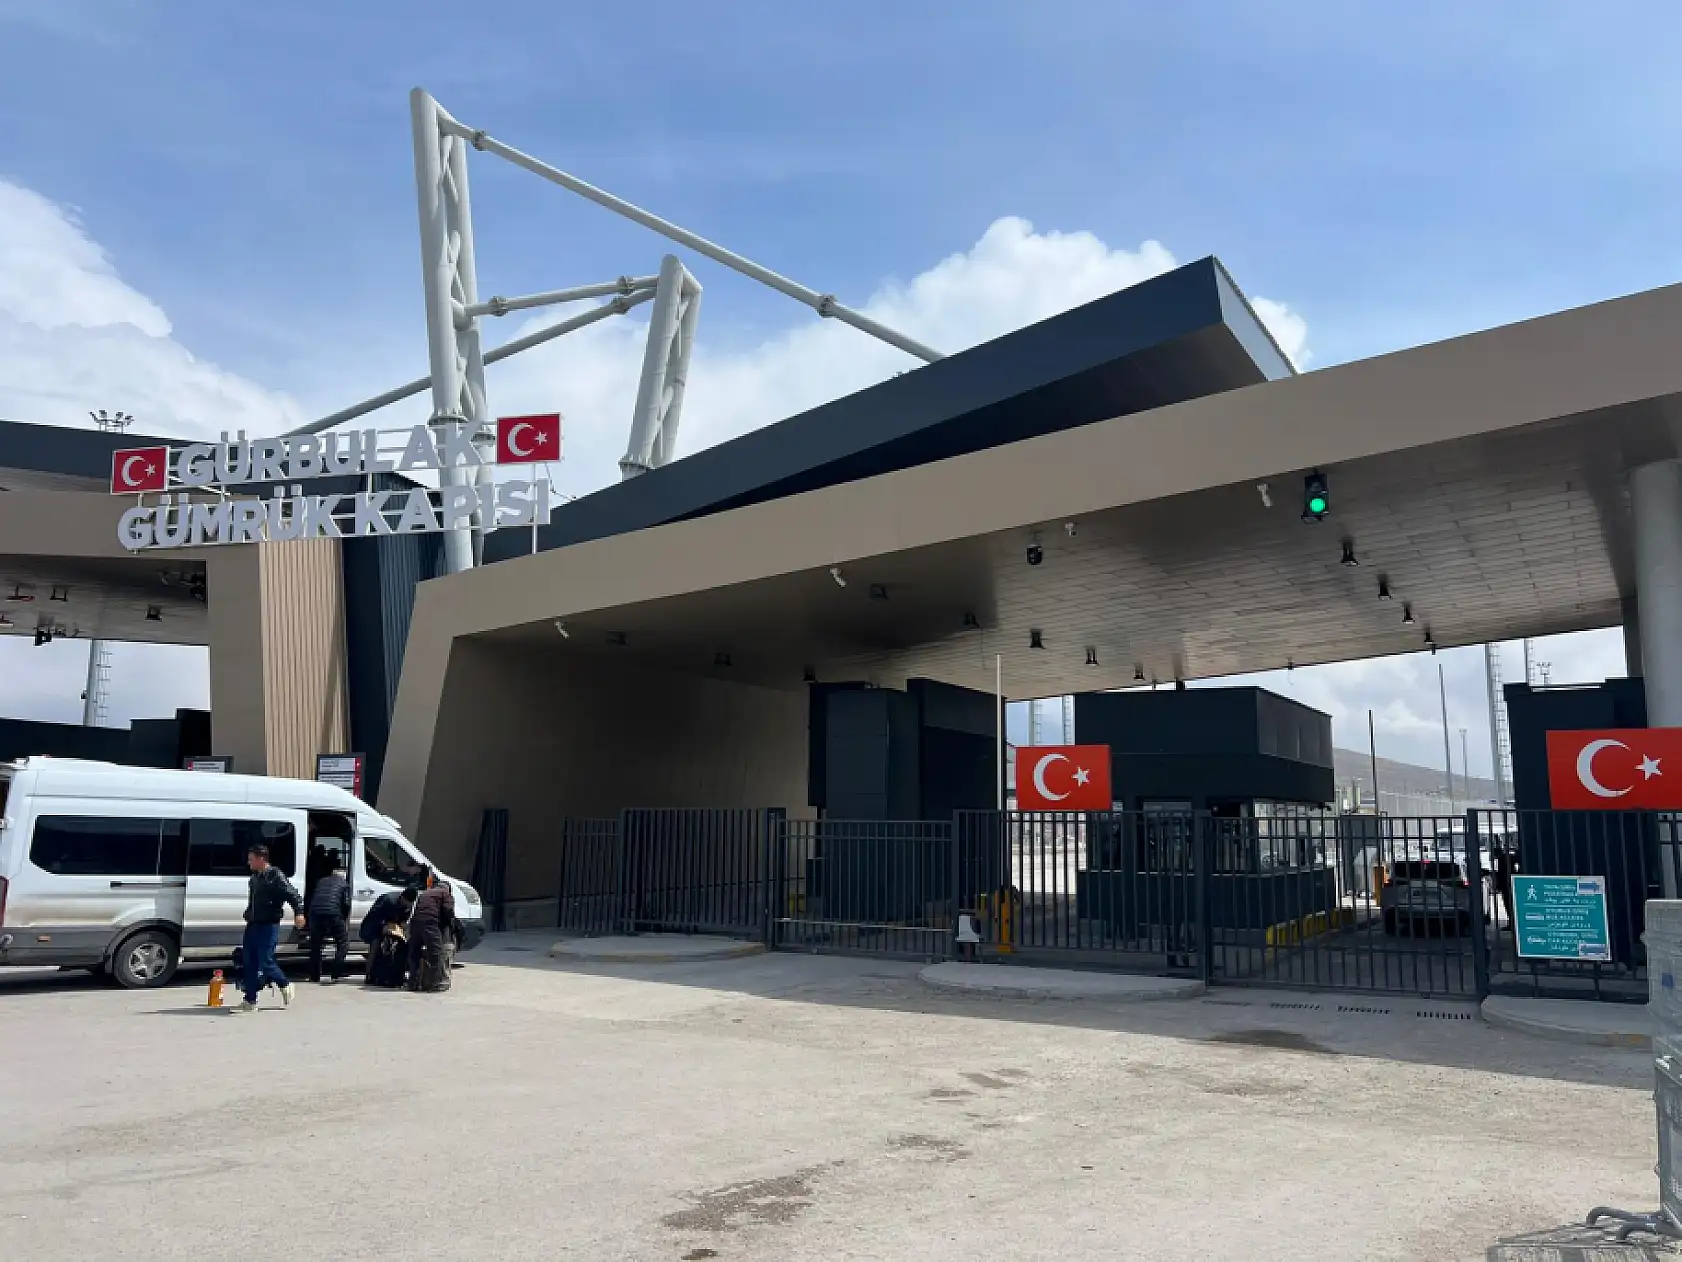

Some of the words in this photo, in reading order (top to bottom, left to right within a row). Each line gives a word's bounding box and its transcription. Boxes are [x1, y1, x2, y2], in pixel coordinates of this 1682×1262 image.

[178, 422, 483, 485] GÜRBULAK
[117, 484, 342, 550] GÜMRÜK
[354, 478, 550, 535] KAPISI
